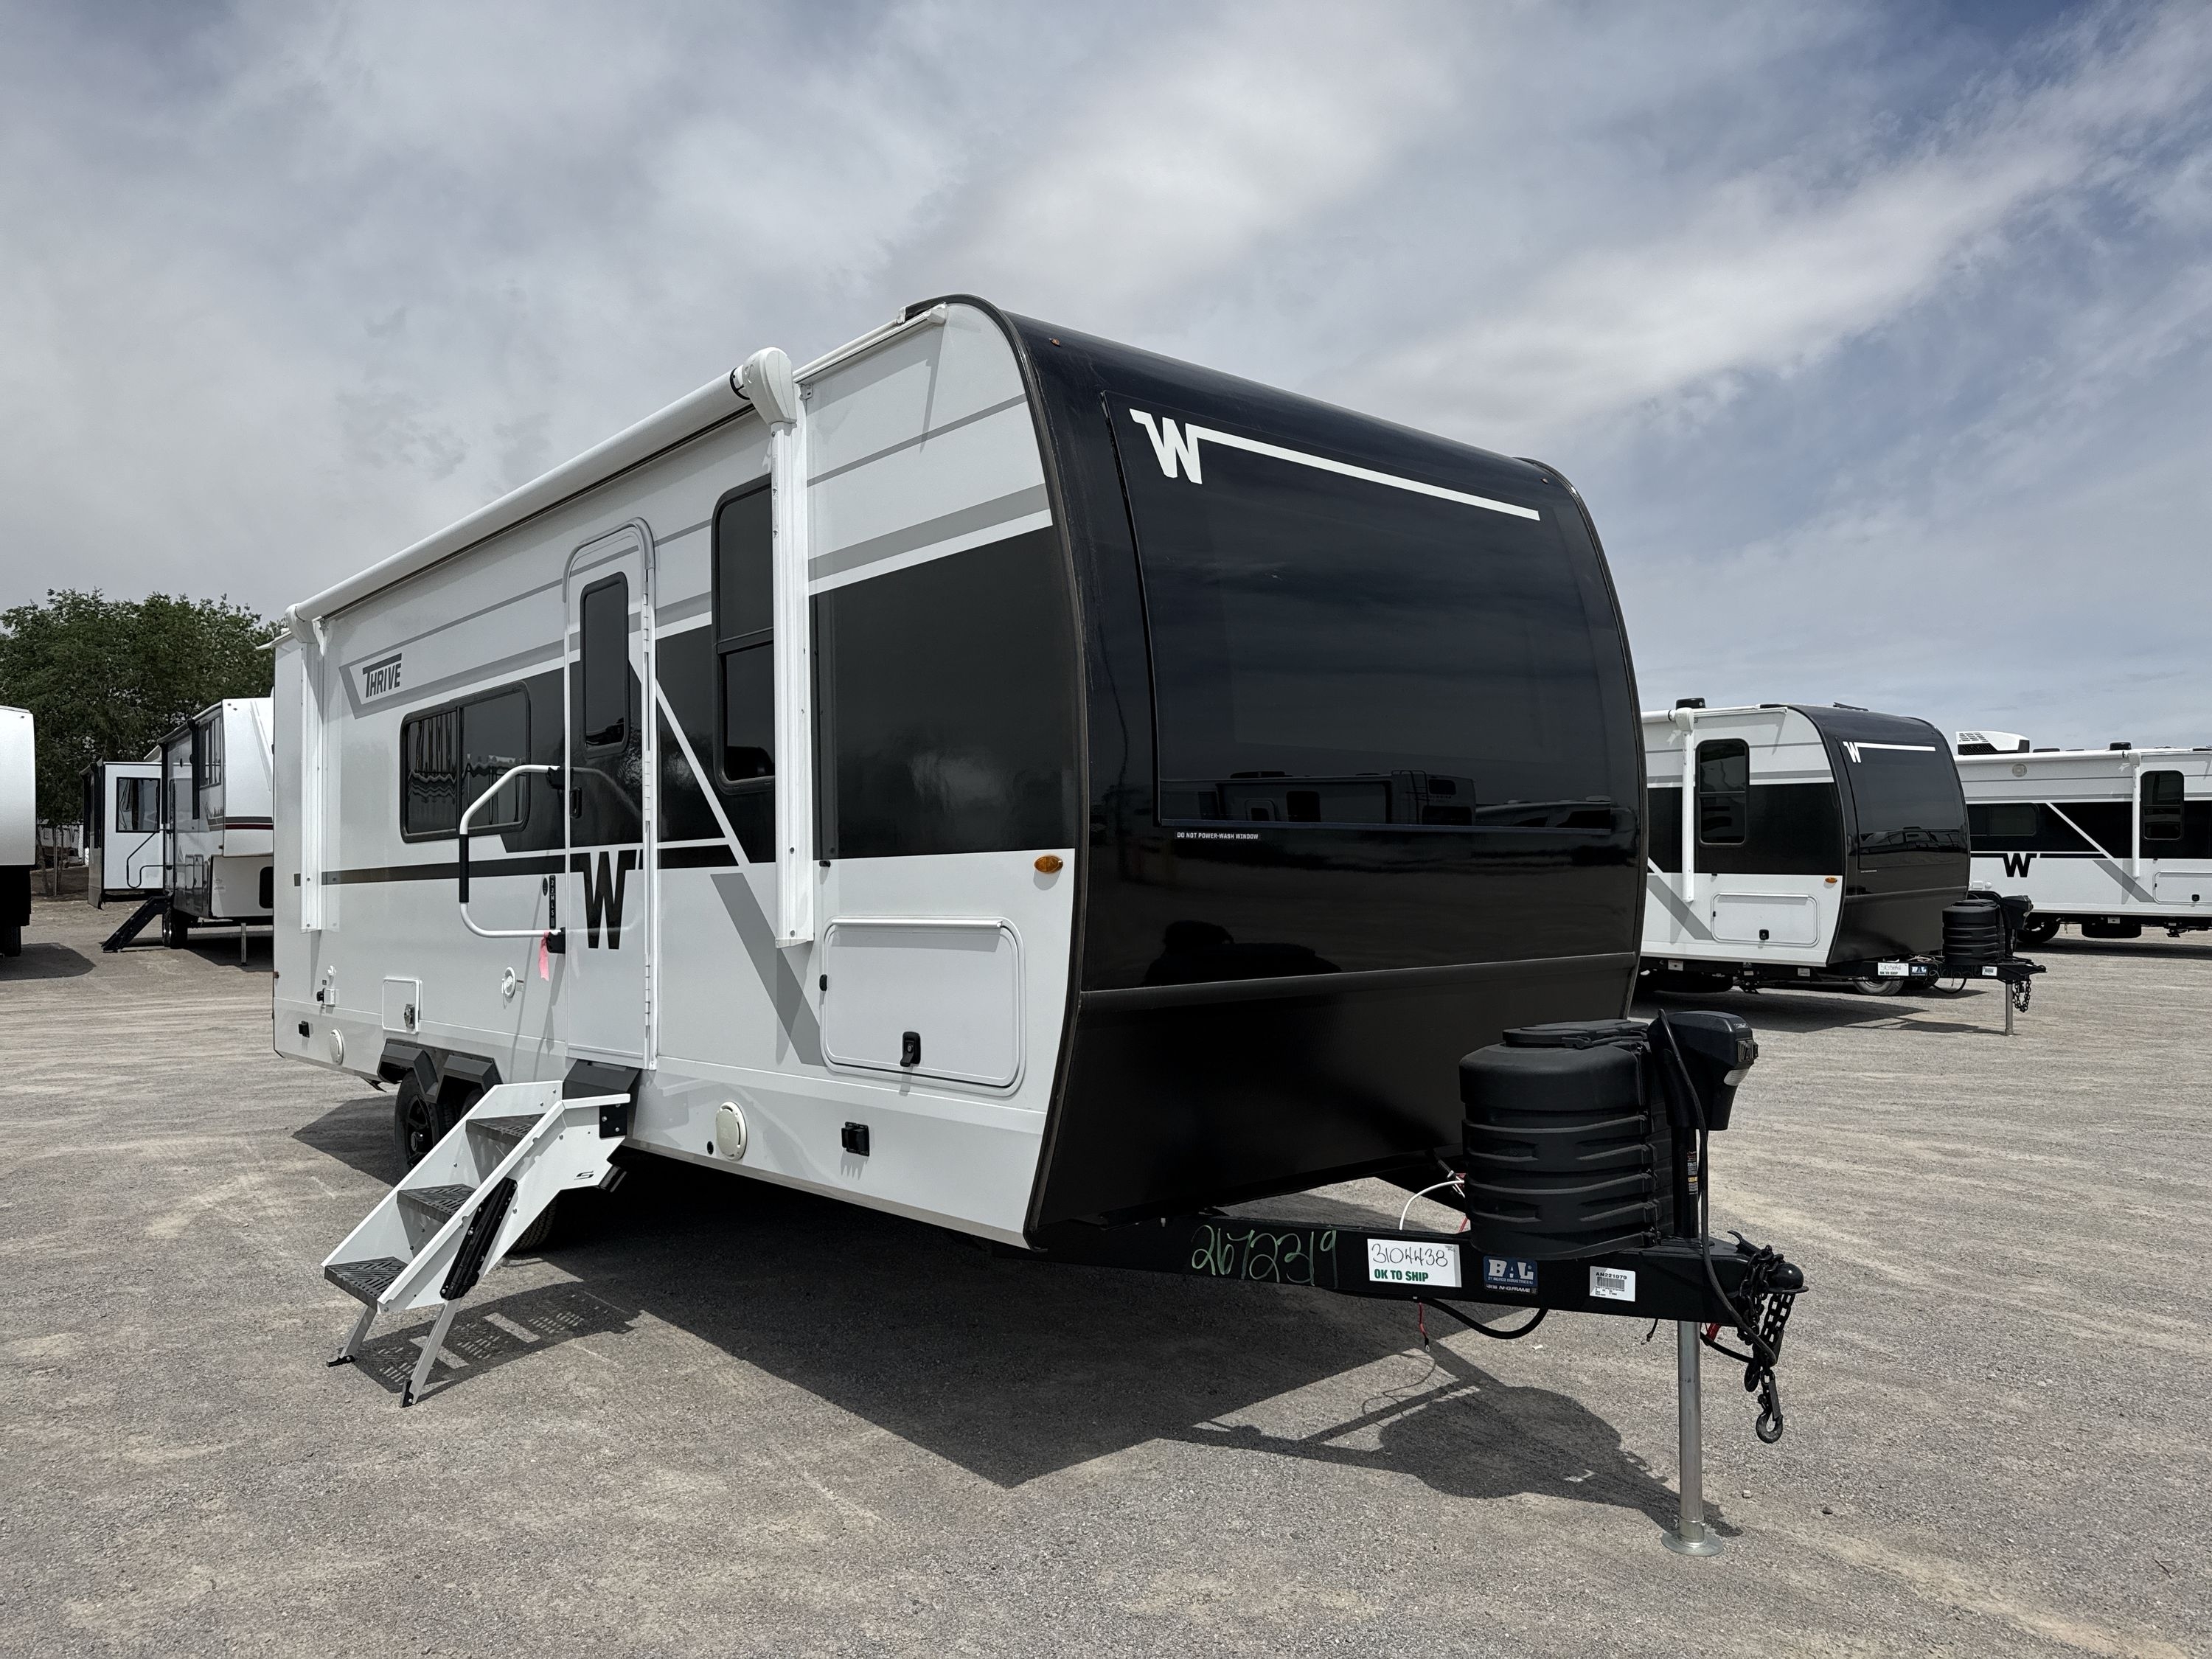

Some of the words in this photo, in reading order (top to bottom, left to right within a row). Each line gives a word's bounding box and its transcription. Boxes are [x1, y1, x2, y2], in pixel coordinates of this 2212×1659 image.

[362, 653, 403, 698] THRIVE
[2001, 852, 2037, 877] W
[570, 849, 637, 950] W
[1371, 1243, 1448, 1267] 3104438
[1374, 1268, 1388, 1279] OK
[1390, 1270, 1403, 1281] TO
[1405, 1270, 1429, 1282] SHIP
[1488, 1259, 1534, 1280] BAL
